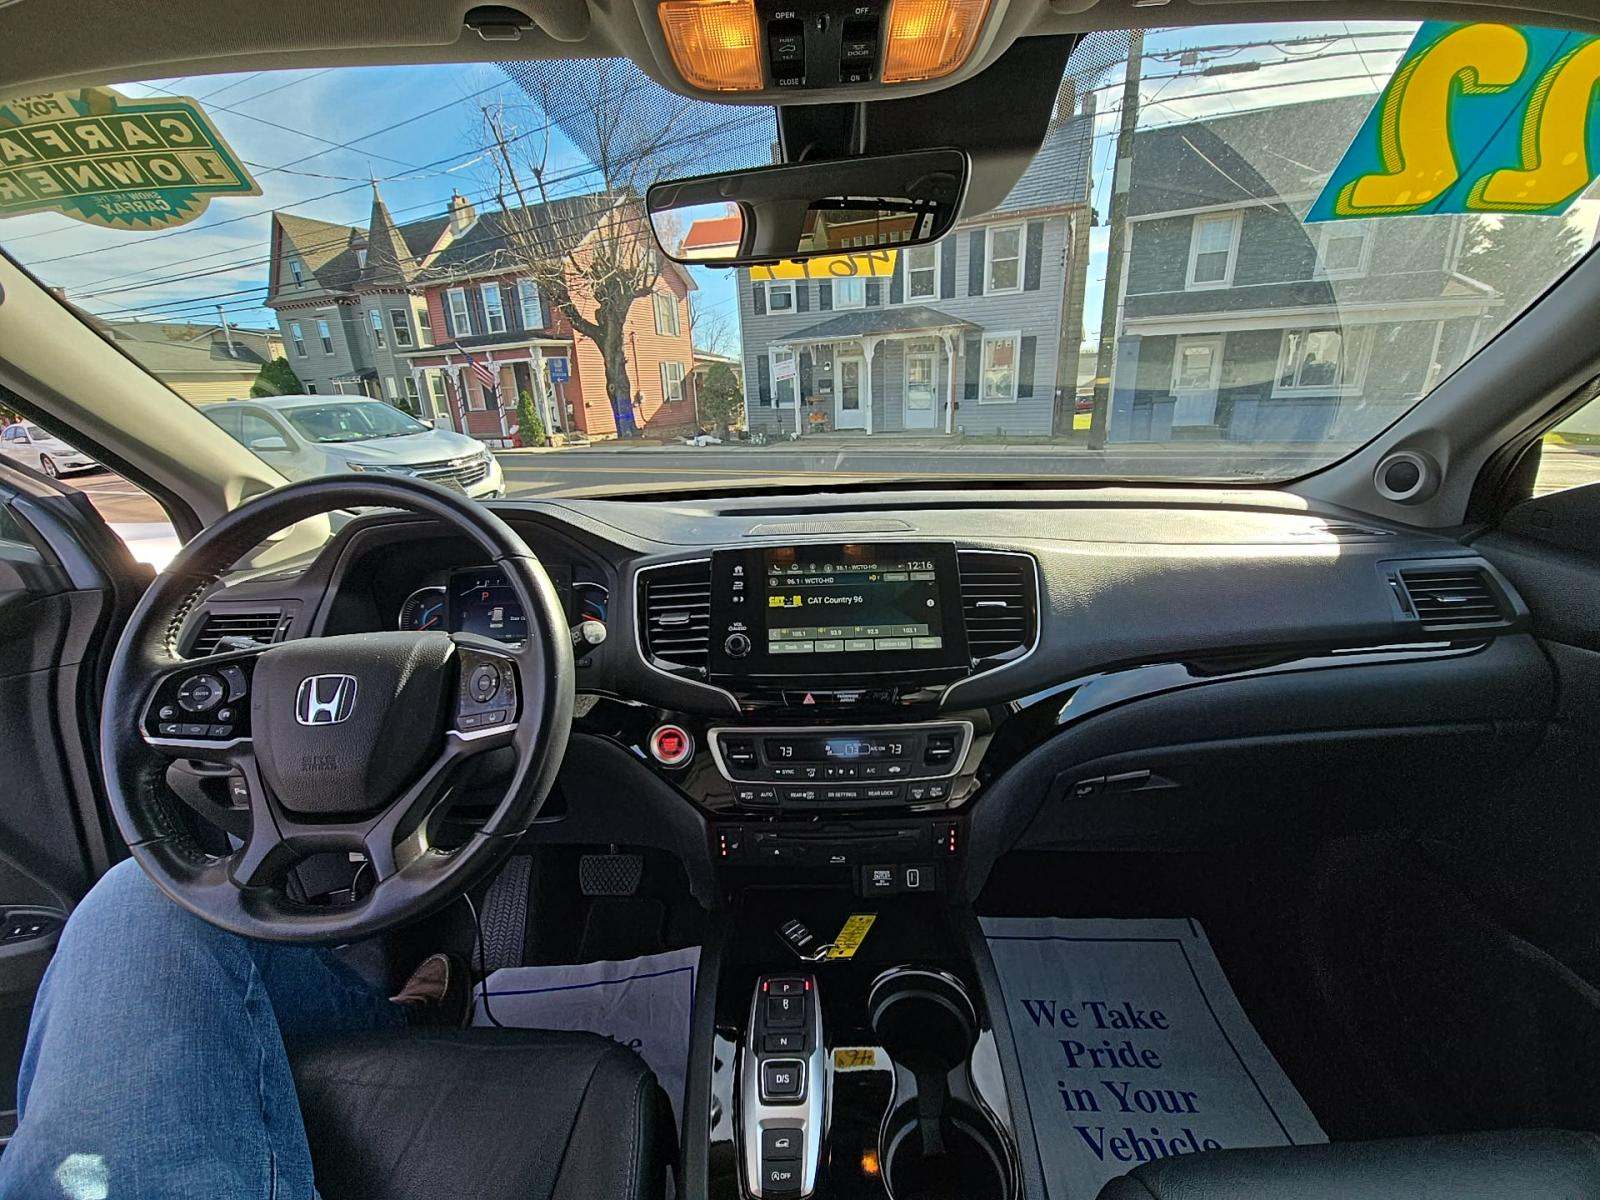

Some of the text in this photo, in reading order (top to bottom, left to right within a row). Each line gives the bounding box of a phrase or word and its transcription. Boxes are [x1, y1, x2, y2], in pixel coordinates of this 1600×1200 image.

[775, 11, 795, 19] OPEN
[855, 7, 870, 15] OFF
[779, 78, 799, 86] CLOSE
[907, 561, 933, 570] 12:16
[482, 592, 489, 600] P
[807, 597, 823, 605] CAT
[823, 595, 852, 605] Country
[853, 595, 863, 603] 96
[780, 746, 792, 757] 73
[889, 744, 902, 754] 73
[784, 984, 790, 992] P
[1020, 999, 1170, 1030] We Take
[780, 1038, 788, 1046] N
[1057, 1038, 1163, 1070] Pride
[776, 1073, 790, 1085] D/S
[1057, 1080, 1201, 1115] in Your
